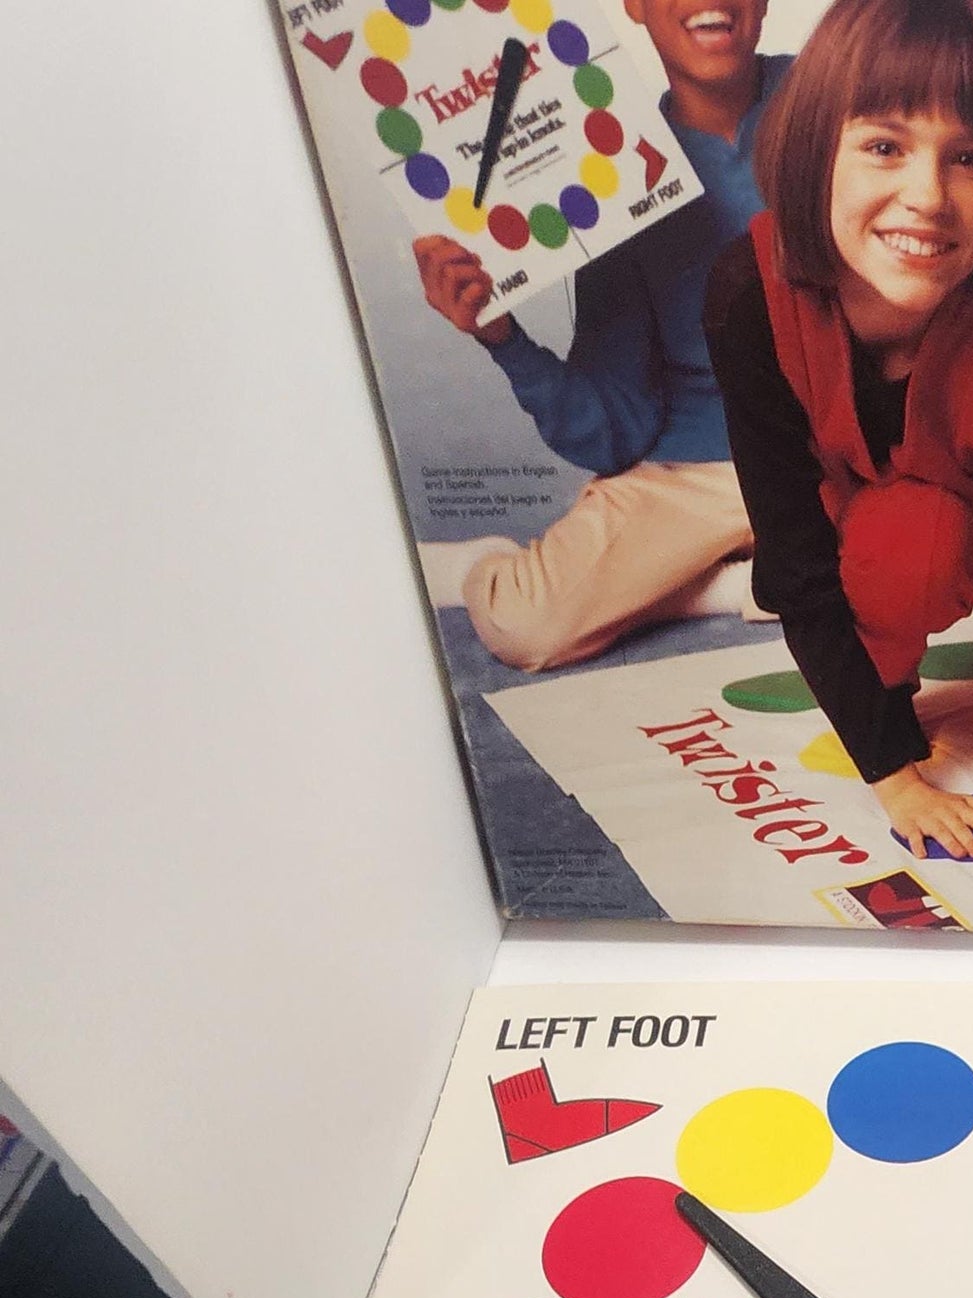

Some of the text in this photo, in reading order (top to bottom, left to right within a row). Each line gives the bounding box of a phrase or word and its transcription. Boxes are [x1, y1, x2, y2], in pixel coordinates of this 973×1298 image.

[628, 178, 684, 220] RIGHT FOOT
[497, 269, 529, 297] HAND
[424, 480, 443, 490] and
[522, 465, 559, 479] English
[636, 707, 870, 865] Twister
[495, 1014, 717, 1051] LEFT FOOT
